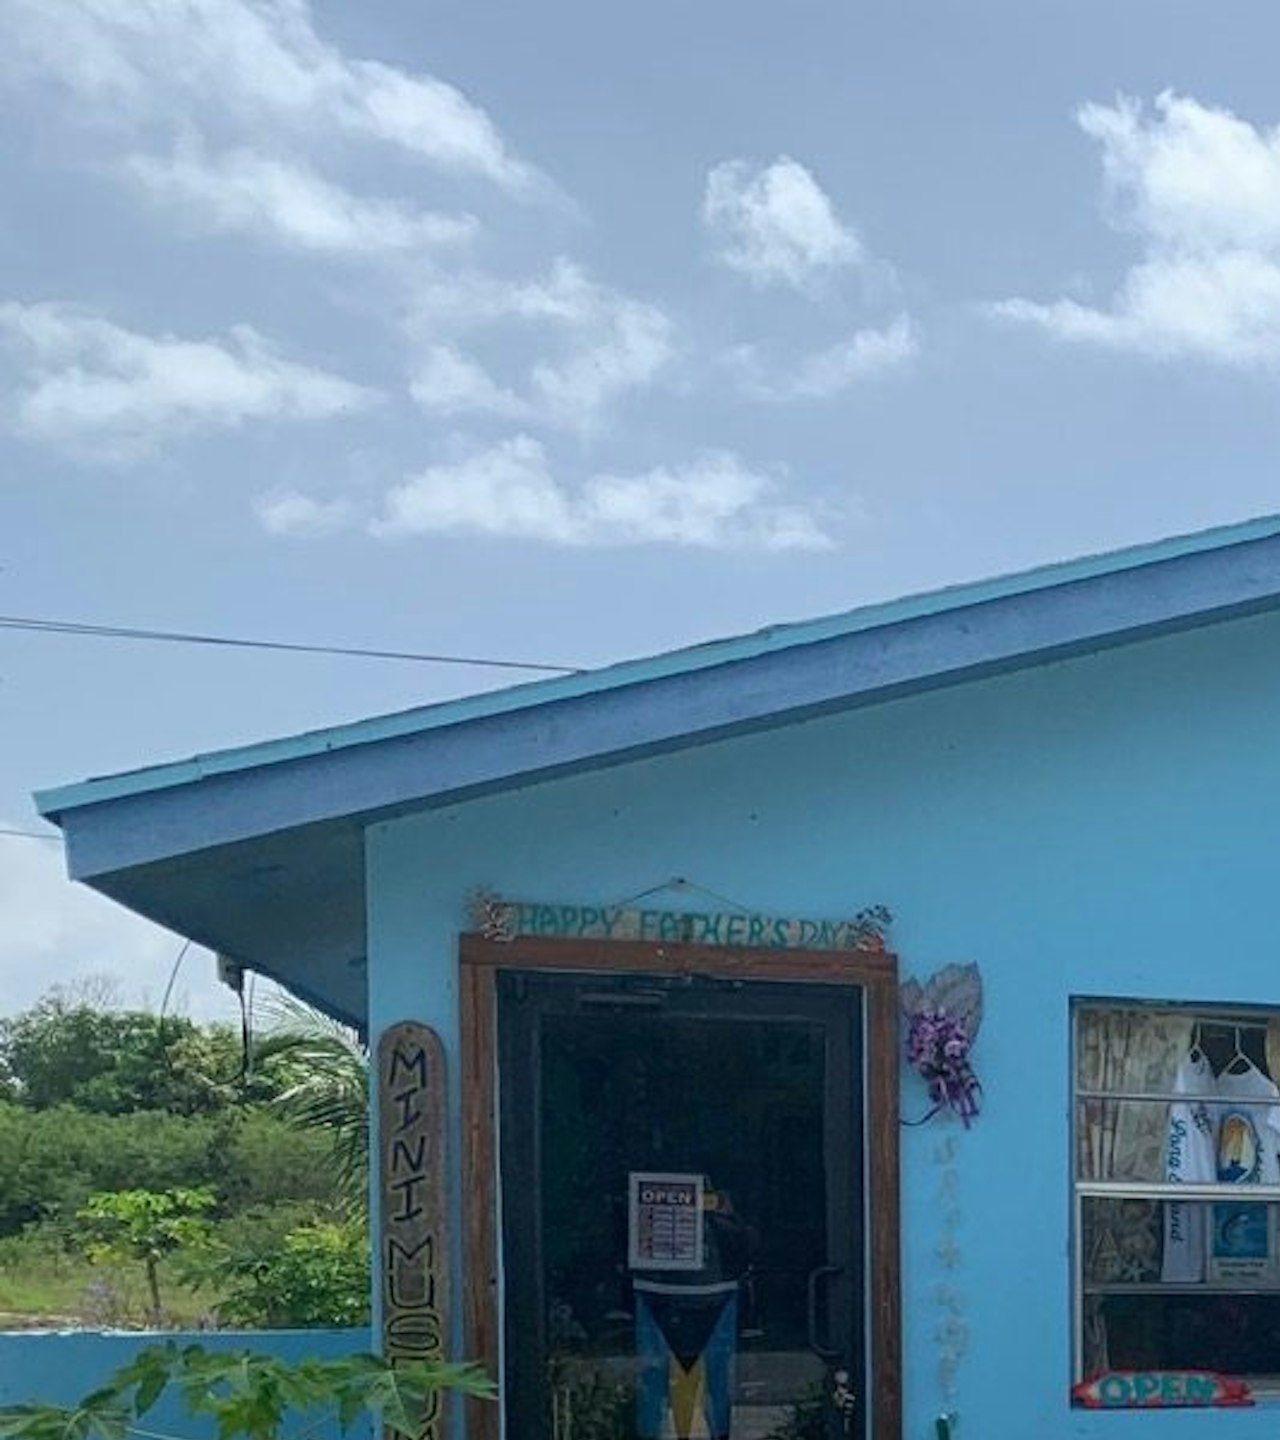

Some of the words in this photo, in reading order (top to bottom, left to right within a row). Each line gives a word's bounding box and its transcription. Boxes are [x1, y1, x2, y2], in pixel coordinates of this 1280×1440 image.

[517, 904, 623, 936] HAPPY
[640, 909, 790, 949] FATHER'S
[800, 919, 846, 946] DAY
[641, 1190, 693, 1204] OPEN
[1100, 1373, 1218, 1407] OPEN
